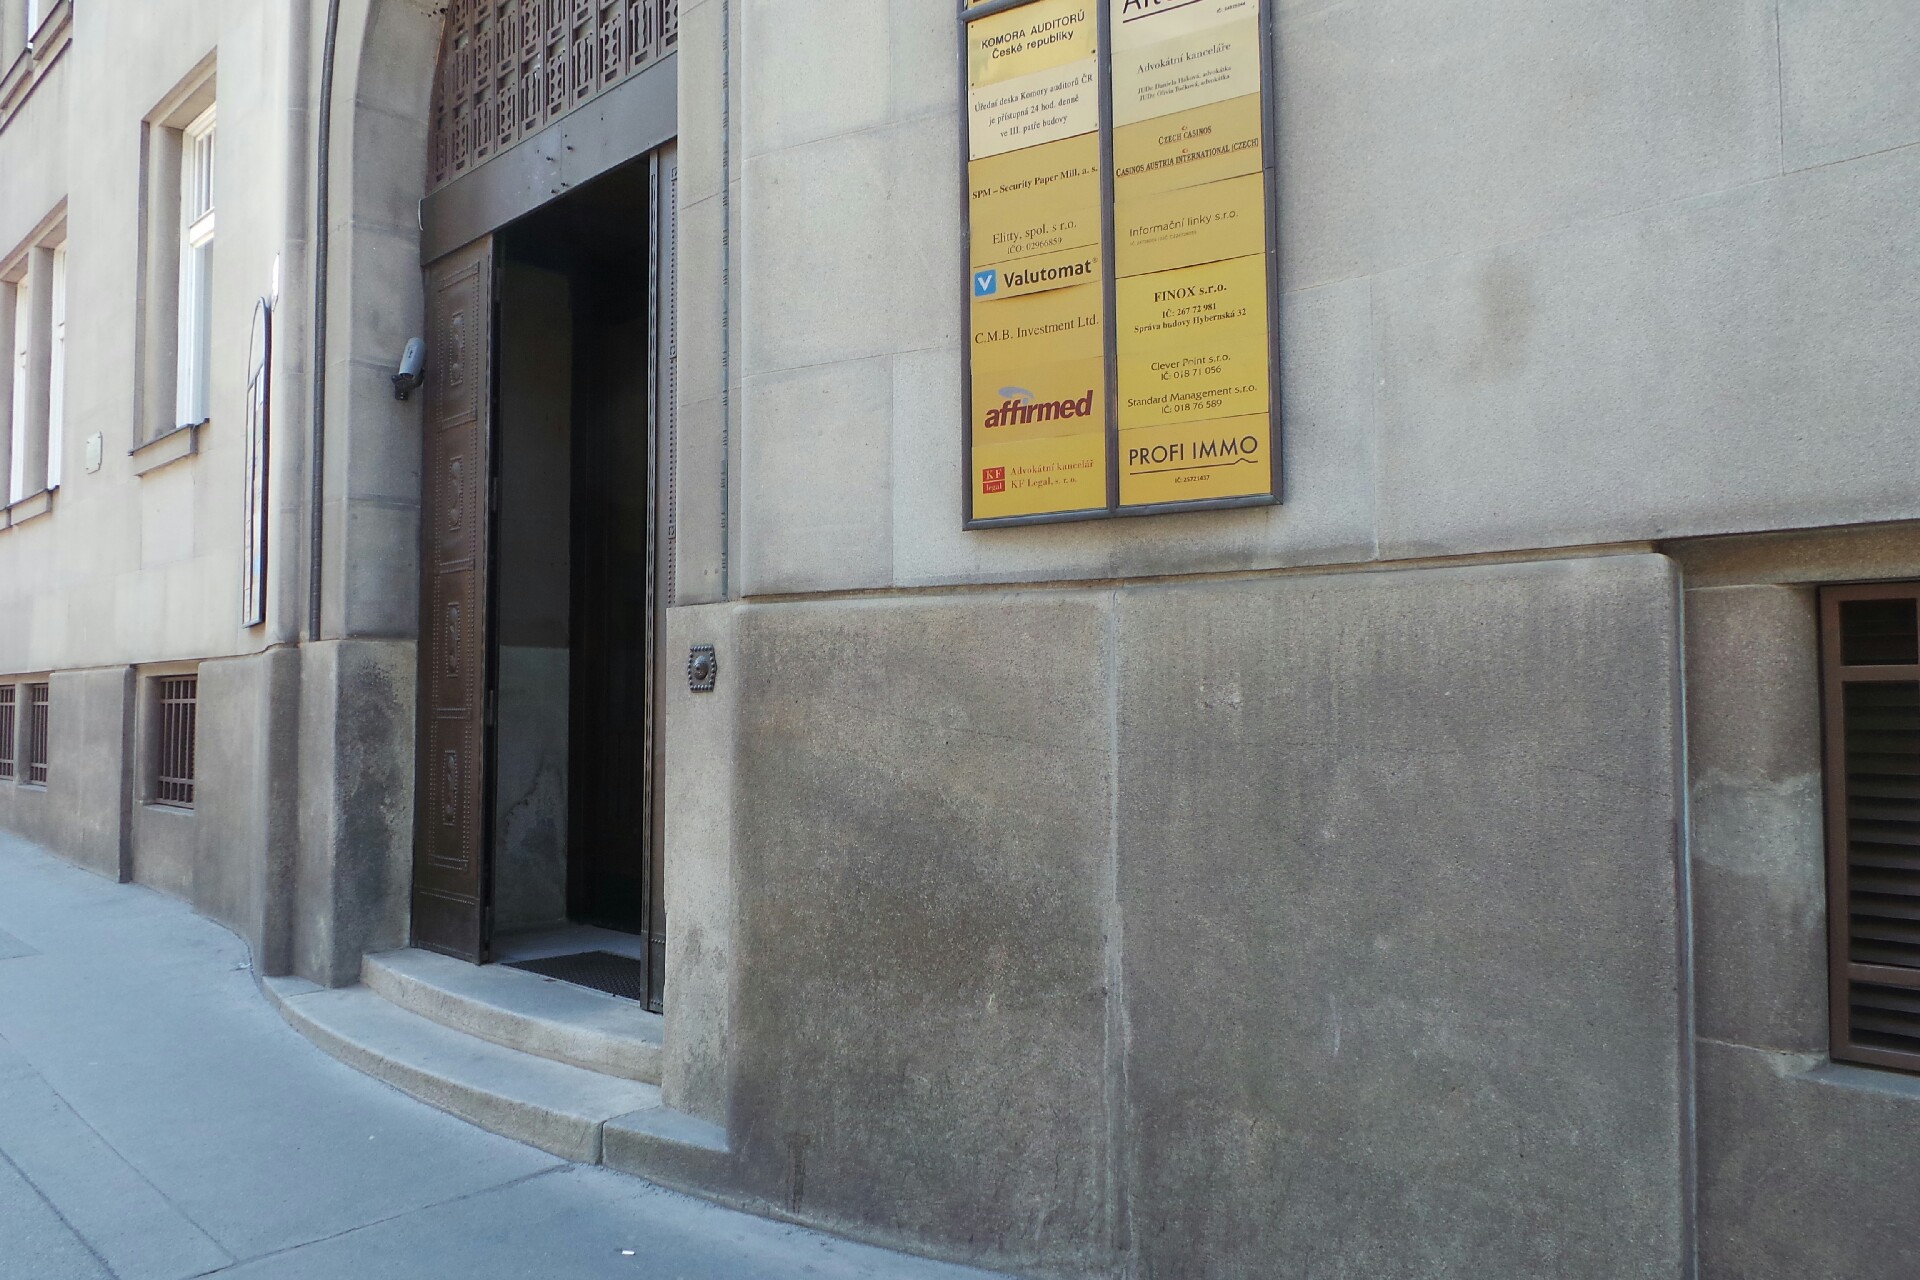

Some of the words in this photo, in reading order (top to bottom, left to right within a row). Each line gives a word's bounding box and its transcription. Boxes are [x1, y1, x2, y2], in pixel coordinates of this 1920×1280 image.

[982, 30, 1025, 49] KOMORA
[992, 43, 1022, 58] České
[1027, 30, 1073, 49] republiky
[1137, 57, 1182, 74] Advokátní
[1186, 43, 1231, 61] kanceláře
[975, 99, 998, 112] Úřední
[1000, 95, 1018, 105] deska
[1021, 87, 1047, 100] Komory
[1050, 79, 1078, 93] auditorů
[1081, 74, 1092, 83] ČR
[989, 117, 995, 127] je
[998, 107, 1028, 124] přístupná
[1031, 105, 1038, 114] 24
[1041, 101, 1055, 111] hod.
[1058, 96, 1079, 106] denně
[1010, 127, 1019, 135] III.
[1023, 123, 1040, 134] patře
[1043, 115, 1067, 127] budovy
[1158, 133, 1181, 144] CZECH
[1184, 126, 1211, 138] CASINOS
[1116, 165, 1144, 177] CASINOS
[1146, 158, 1174, 170] AUSTRIA
[1176, 146, 1229, 163] INTERNATIONAL
[973, 188, 991, 199] SPM
[1000, 180, 1032, 193] Security
[1035, 174, 1058, 185] Paper
[1060, 221, 1076, 231] r.o.
[1130, 218, 1184, 236] Informační
[1188, 214, 1211, 226] linky
[1215, 211, 1238, 220] s.r.o.
[1154, 286, 1196, 302] FINOX
[1200, 284, 1226, 295] s.r.o.
[1162, 309, 1174, 318] IČ:
[1204, 303, 1216, 311] 981
[975, 330, 1013, 344] C.M.B.
[1017, 320, 1074, 338] Investment
[1078, 314, 1099, 328] Ltd.
[1134, 322, 1160, 334] Správa
[1163, 318, 1190, 330] budovy
[1193, 311, 1235, 325] Hybernská
[1151, 362, 1179, 371] Clever
[1182, 357, 1205, 366] Point
[1209, 354, 1230, 363] s.r.o.
[1174, 370, 1189, 378] 018
[1193, 368, 1201, 376] 71
[1205, 366, 1221, 374] 056
[1128, 395, 1167, 407] Standard
[1170, 386, 1232, 402] Management
[1235, 385, 1256, 393] s.r.o.
[985, 390, 1093, 428] affirmed
[1162, 404, 1172, 414] IČ:
[1174, 404, 1190, 412] 018
[1193, 401, 1203, 409] 76
[1206, 400, 1222, 408] 589
[1130, 444, 1183, 465] PROFI
[1193, 436, 1257, 459] IMMO
[1011, 463, 1054, 476] Advokátní
[1057, 460, 1094, 471] kancelář
[987, 483, 1002, 492] legal
[1011, 480, 1025, 488] KF
